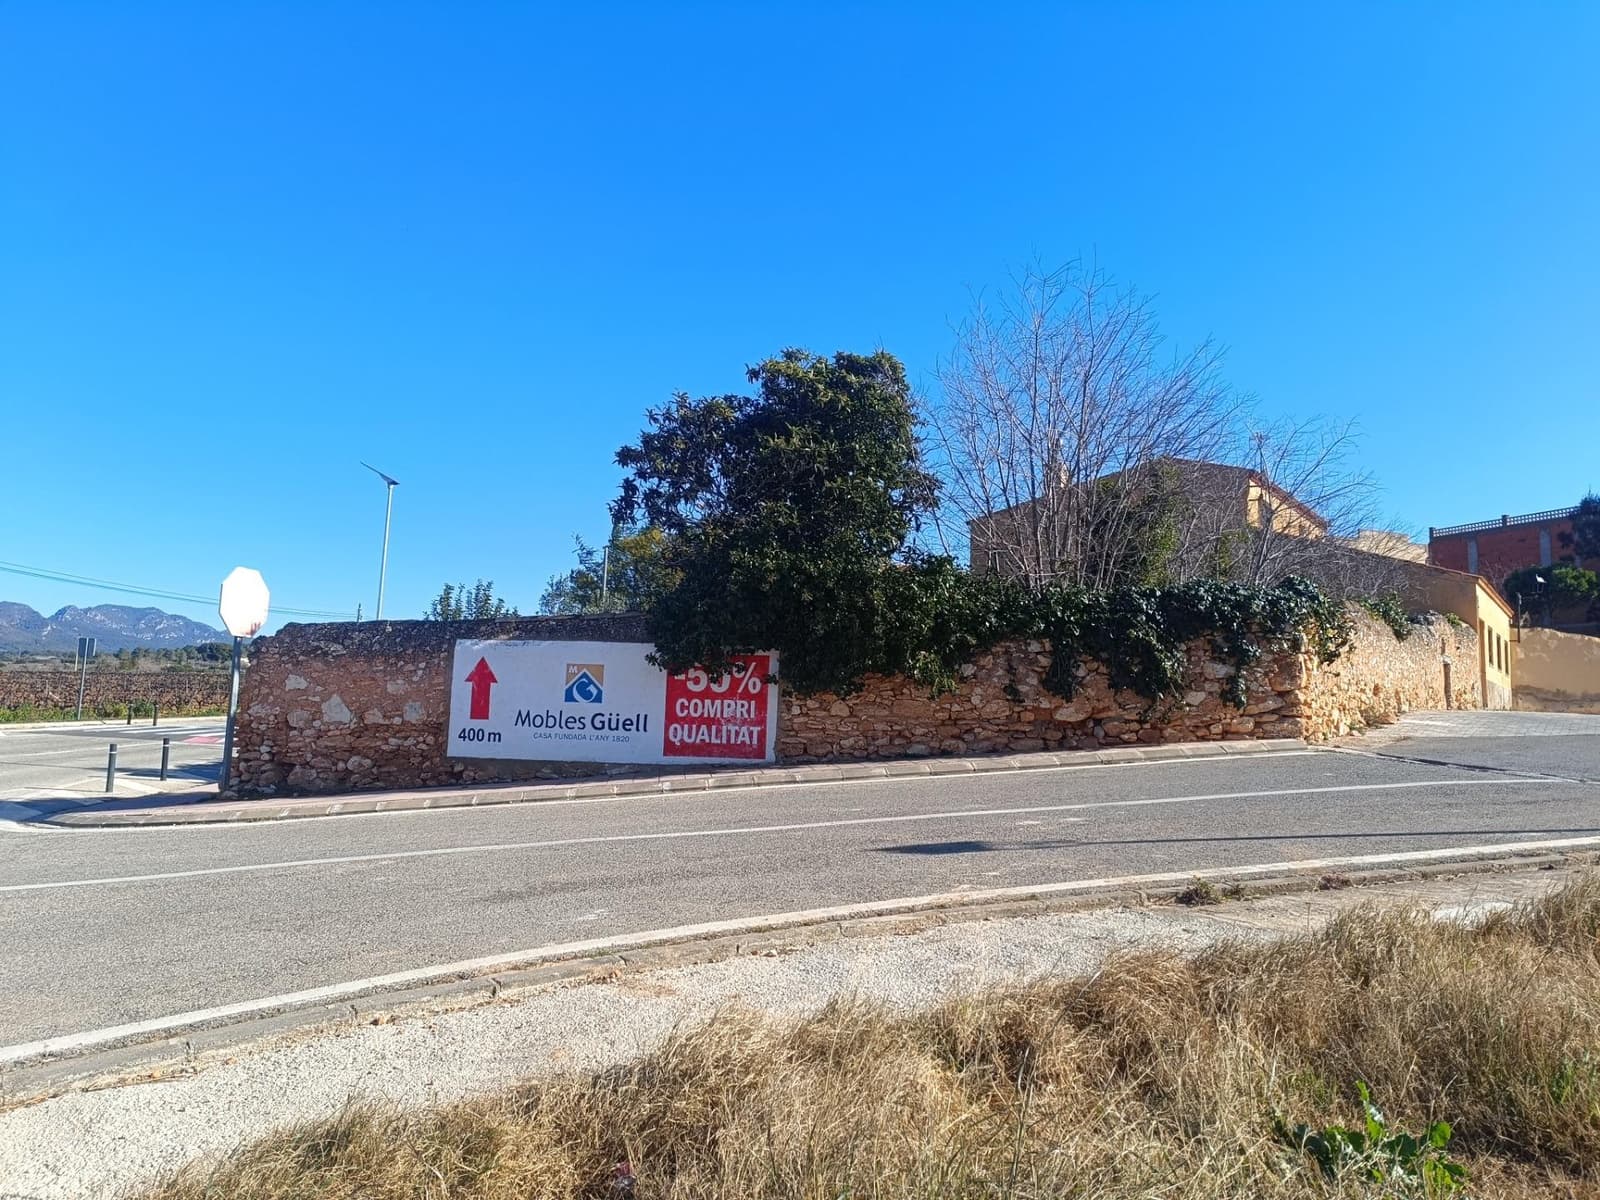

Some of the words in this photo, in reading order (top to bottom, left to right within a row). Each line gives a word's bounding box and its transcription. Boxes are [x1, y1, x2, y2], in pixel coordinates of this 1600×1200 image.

[675, 698, 756, 718] COMPRI
[514, 709, 586, 730] Mobles
[591, 712, 648, 733] Güell
[458, 728, 485, 742] 400
[487, 731, 502, 743] m
[533, 732, 552, 740] CASA
[554, 733, 587, 741] FUNDADA
[589, 734, 610, 742] L'ANY
[612, 735, 630, 743] 1820
[669, 723, 761, 745] QUALITAT
